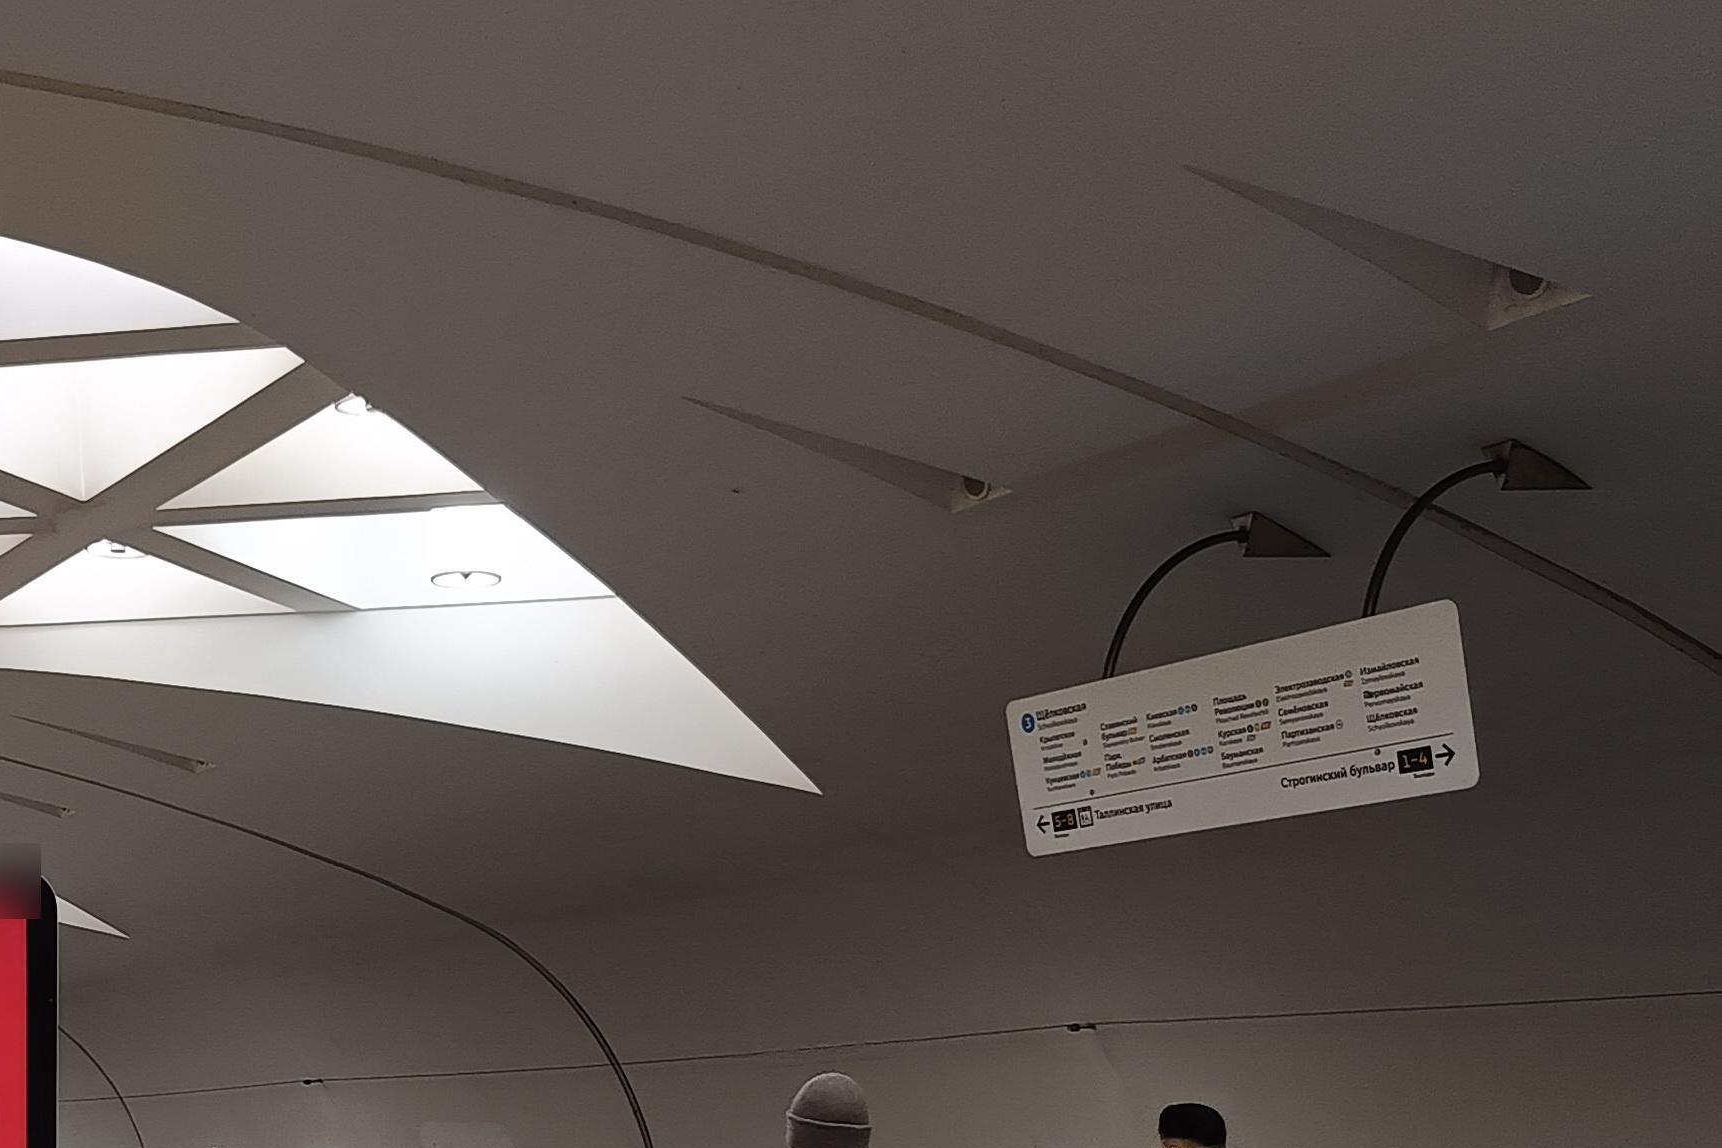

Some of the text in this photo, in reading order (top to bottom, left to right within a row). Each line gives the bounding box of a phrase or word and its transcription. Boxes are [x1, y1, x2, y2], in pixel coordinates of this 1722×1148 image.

[1360, 657, 1420, 676] Измайловская
[1274, 674, 1345, 694] Электрозаводская
[1366, 707, 1418, 723] Щёлковская
[1281, 723, 1335, 739] Партизанская
[1280, 752, 1428, 789] Строгинский бульвар 1-4
[1054, 814, 1075, 828] 5-8
[1094, 805, 1144, 820] Таллинская
[1145, 800, 1173, 814] улица
